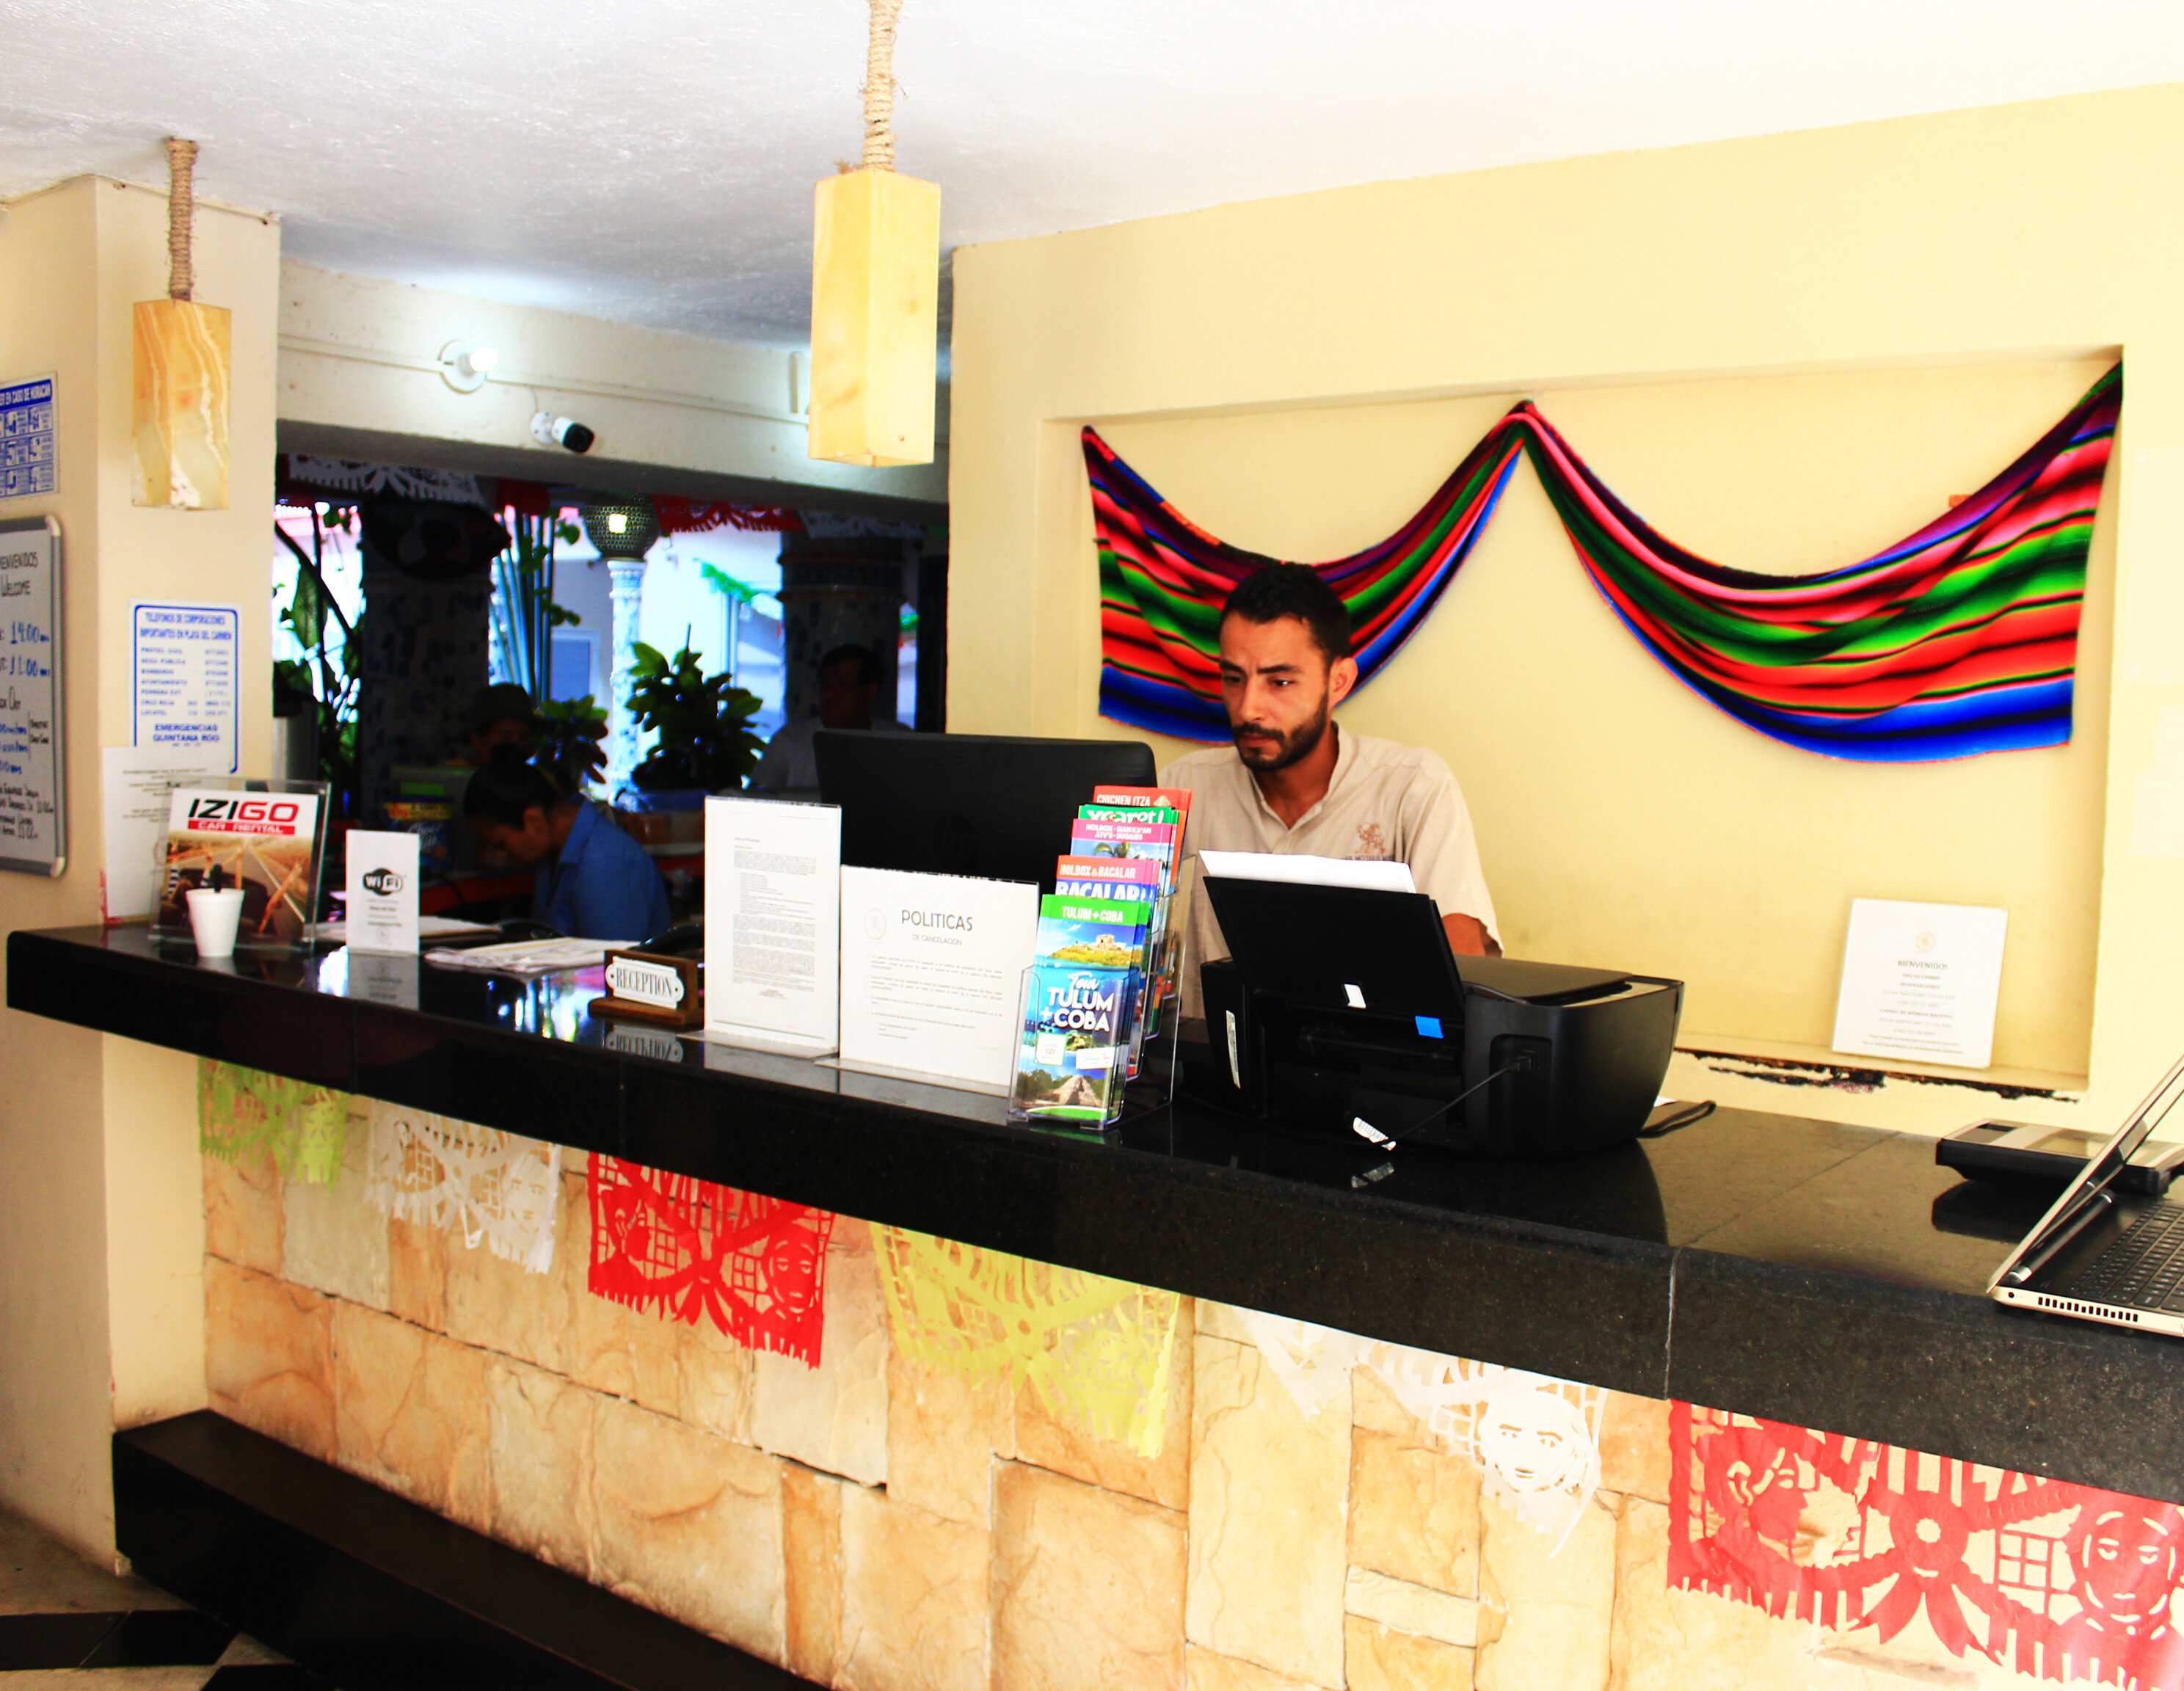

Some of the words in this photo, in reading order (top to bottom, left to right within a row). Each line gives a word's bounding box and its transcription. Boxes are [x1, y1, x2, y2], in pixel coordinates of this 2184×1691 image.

[155, 724, 217, 732] EMERGENCIAS
[153, 734, 198, 742] QUINTANA
[1096, 794, 1131, 806] CHICHEN
[1132, 796, 1151, 807] ITZA
[189, 798, 299, 822] IZIGO
[198, 821, 225, 830] CAR
[233, 823, 283, 834] RENTAL
[1060, 864, 1091, 876] HOLBOX
[1098, 866, 1136, 879] BACALAR
[901, 909, 974, 931] POLITICAS
[1062, 906, 1091, 920] TULUM
[1099, 909, 1124, 923] COBA
[1897, 959, 1948, 970] BIENVENIDOS
[616, 967, 672, 999] RECEPTION
[1067, 970, 1100, 991] Tour
[1047, 986, 1114, 1012] TULUM
